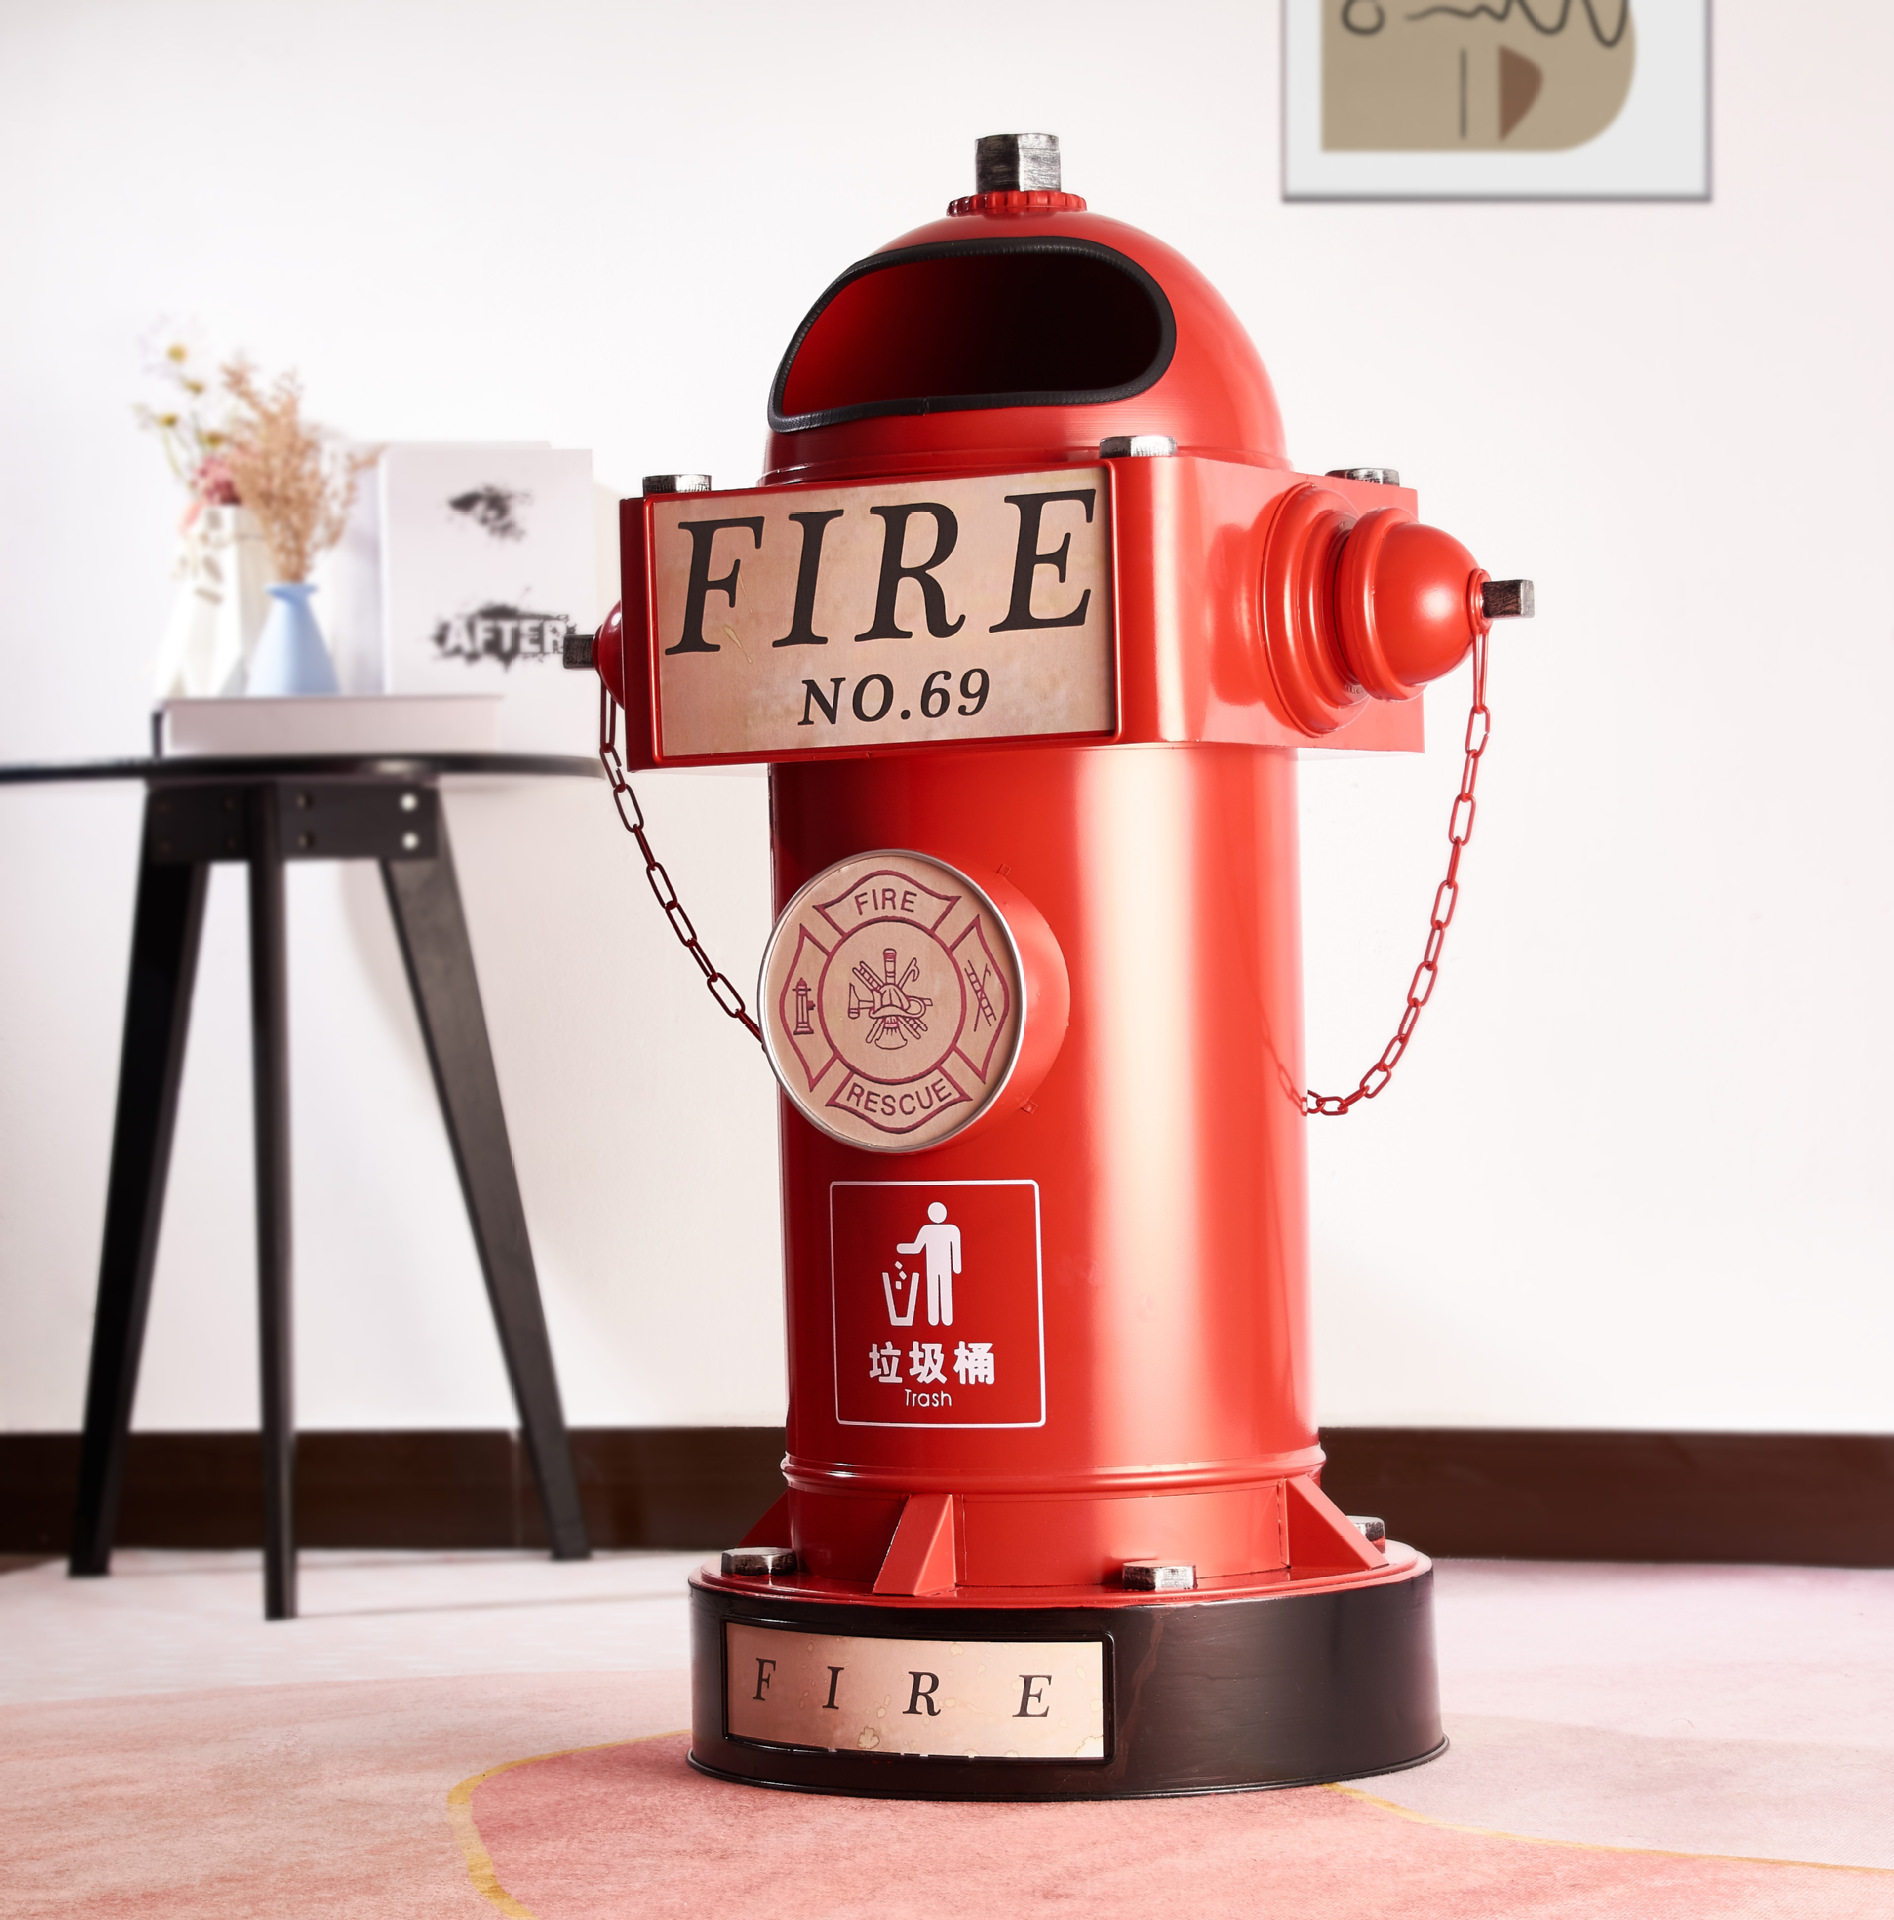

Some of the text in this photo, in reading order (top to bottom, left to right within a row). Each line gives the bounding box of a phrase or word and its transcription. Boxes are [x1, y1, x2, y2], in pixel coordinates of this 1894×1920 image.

[665, 489, 1096, 655] FIRE
[797, 668, 990, 726] NO.69
[854, 888, 917, 915] FIRE
[846, 1078, 952, 1116] RESCUE
[869, 1340, 995, 1385] 垃圾桶
[904, 1388, 952, 1407] Trash
